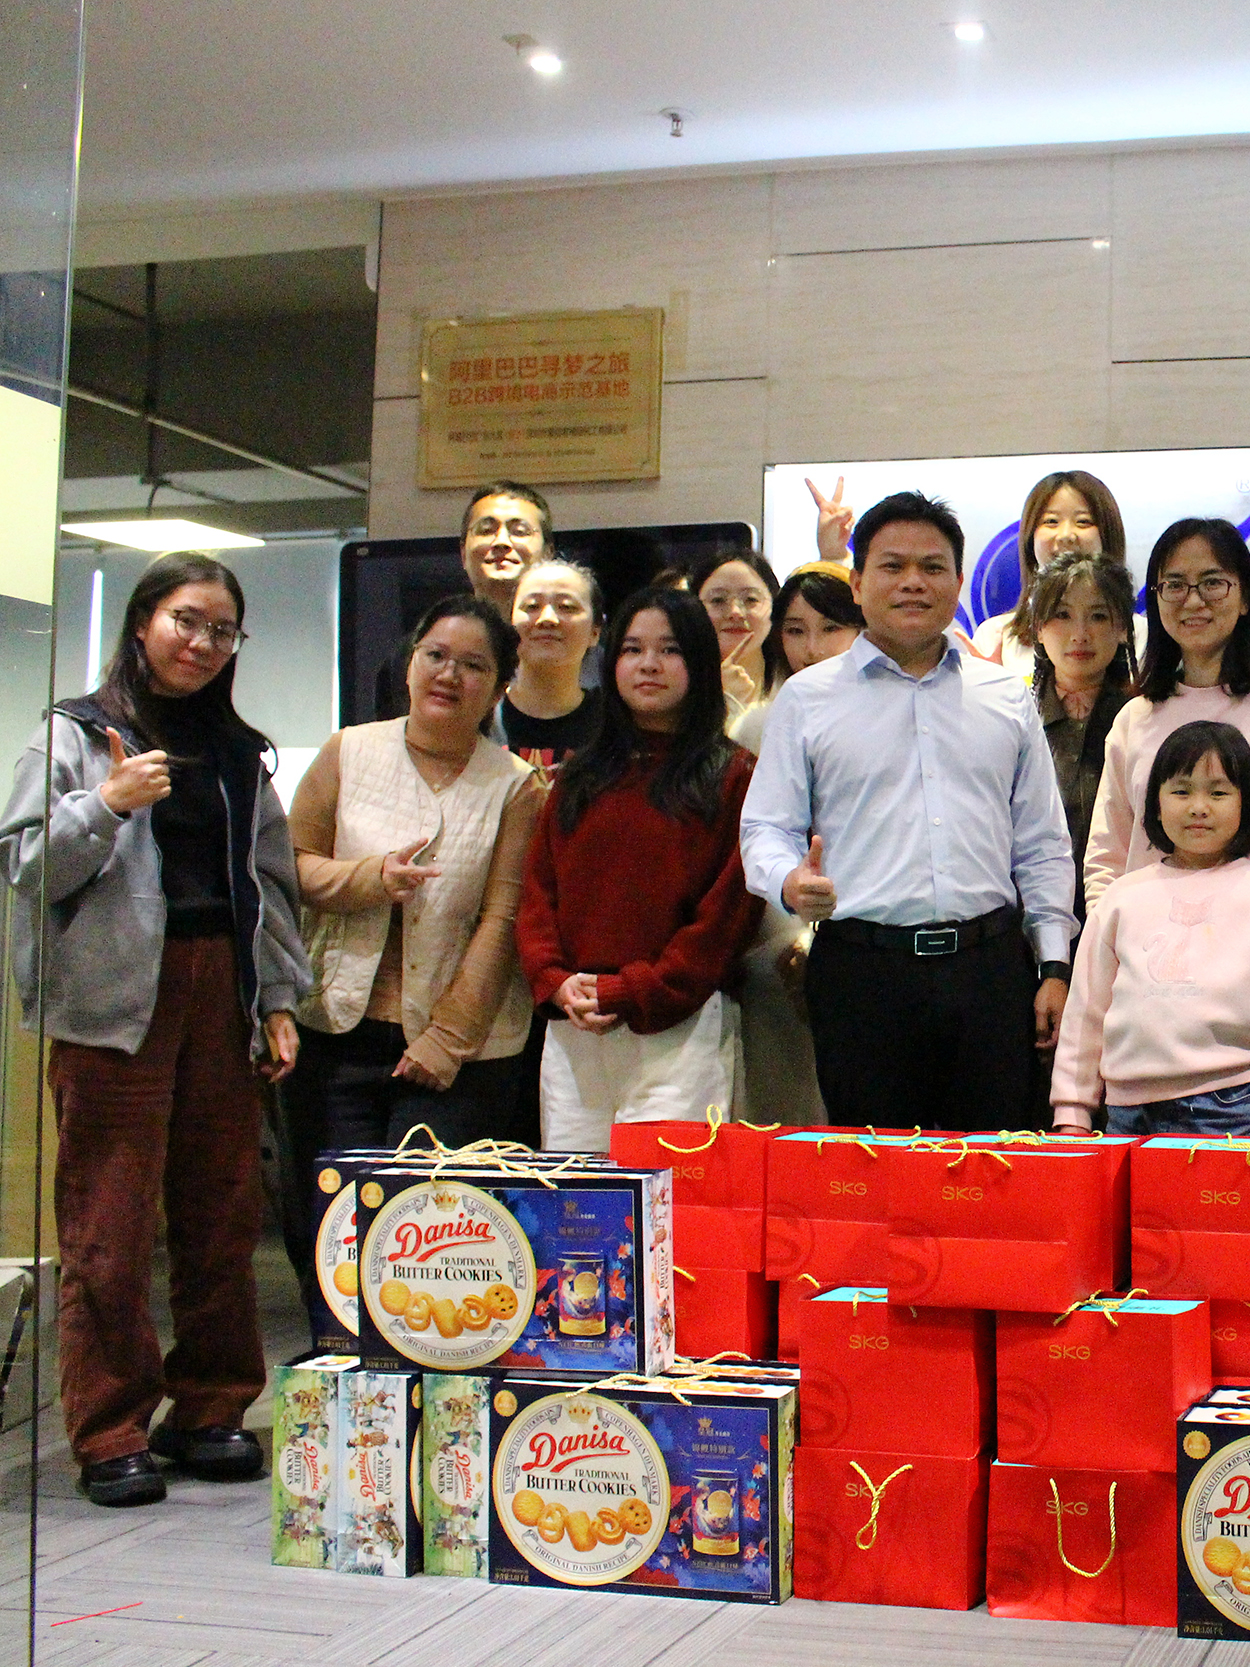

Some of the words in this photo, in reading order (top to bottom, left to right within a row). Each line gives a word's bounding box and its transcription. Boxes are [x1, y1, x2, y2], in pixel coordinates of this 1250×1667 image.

[829, 1181, 867, 1196] SKG
[942, 1186, 983, 1201] SKG
[1200, 1190, 1241, 1205] SKG
[388, 1213, 496, 1262] Danisa
[440, 1256, 496, 1267] TRADITIONAL
[393, 1264, 442, 1280] BUTTER
[444, 1266, 503, 1282] COOKIES
[849, 1335, 889, 1351] SKG
[1211, 1328, 1238, 1341] KG
[1048, 1345, 1091, 1361] SKG
[521, 1424, 630, 1473] Danisa
[286, 1448, 294, 1486] COOKIES
[303, 1441, 323, 1492] Danisa
[355, 1450, 376, 1502] Danisa
[376, 1459, 385, 1493] BUTTER
[438, 1456, 446, 1494] COOKIES
[455, 1450, 475, 1501] Danisa
[574, 1468, 631, 1481] TRADITIONAL
[383, 1458, 392, 1496] COOKIES
[526, 1474, 577, 1492] BUTTER
[579, 1478, 637, 1497] COOKIES
[845, 1484, 886, 1499] SKG
[1046, 1500, 1088, 1516] SKG
[535, 1546, 570, 1569] ORIGINAL
[572, 1564, 601, 1572] DANISH
[602, 1553, 629, 1570] RECIPE
